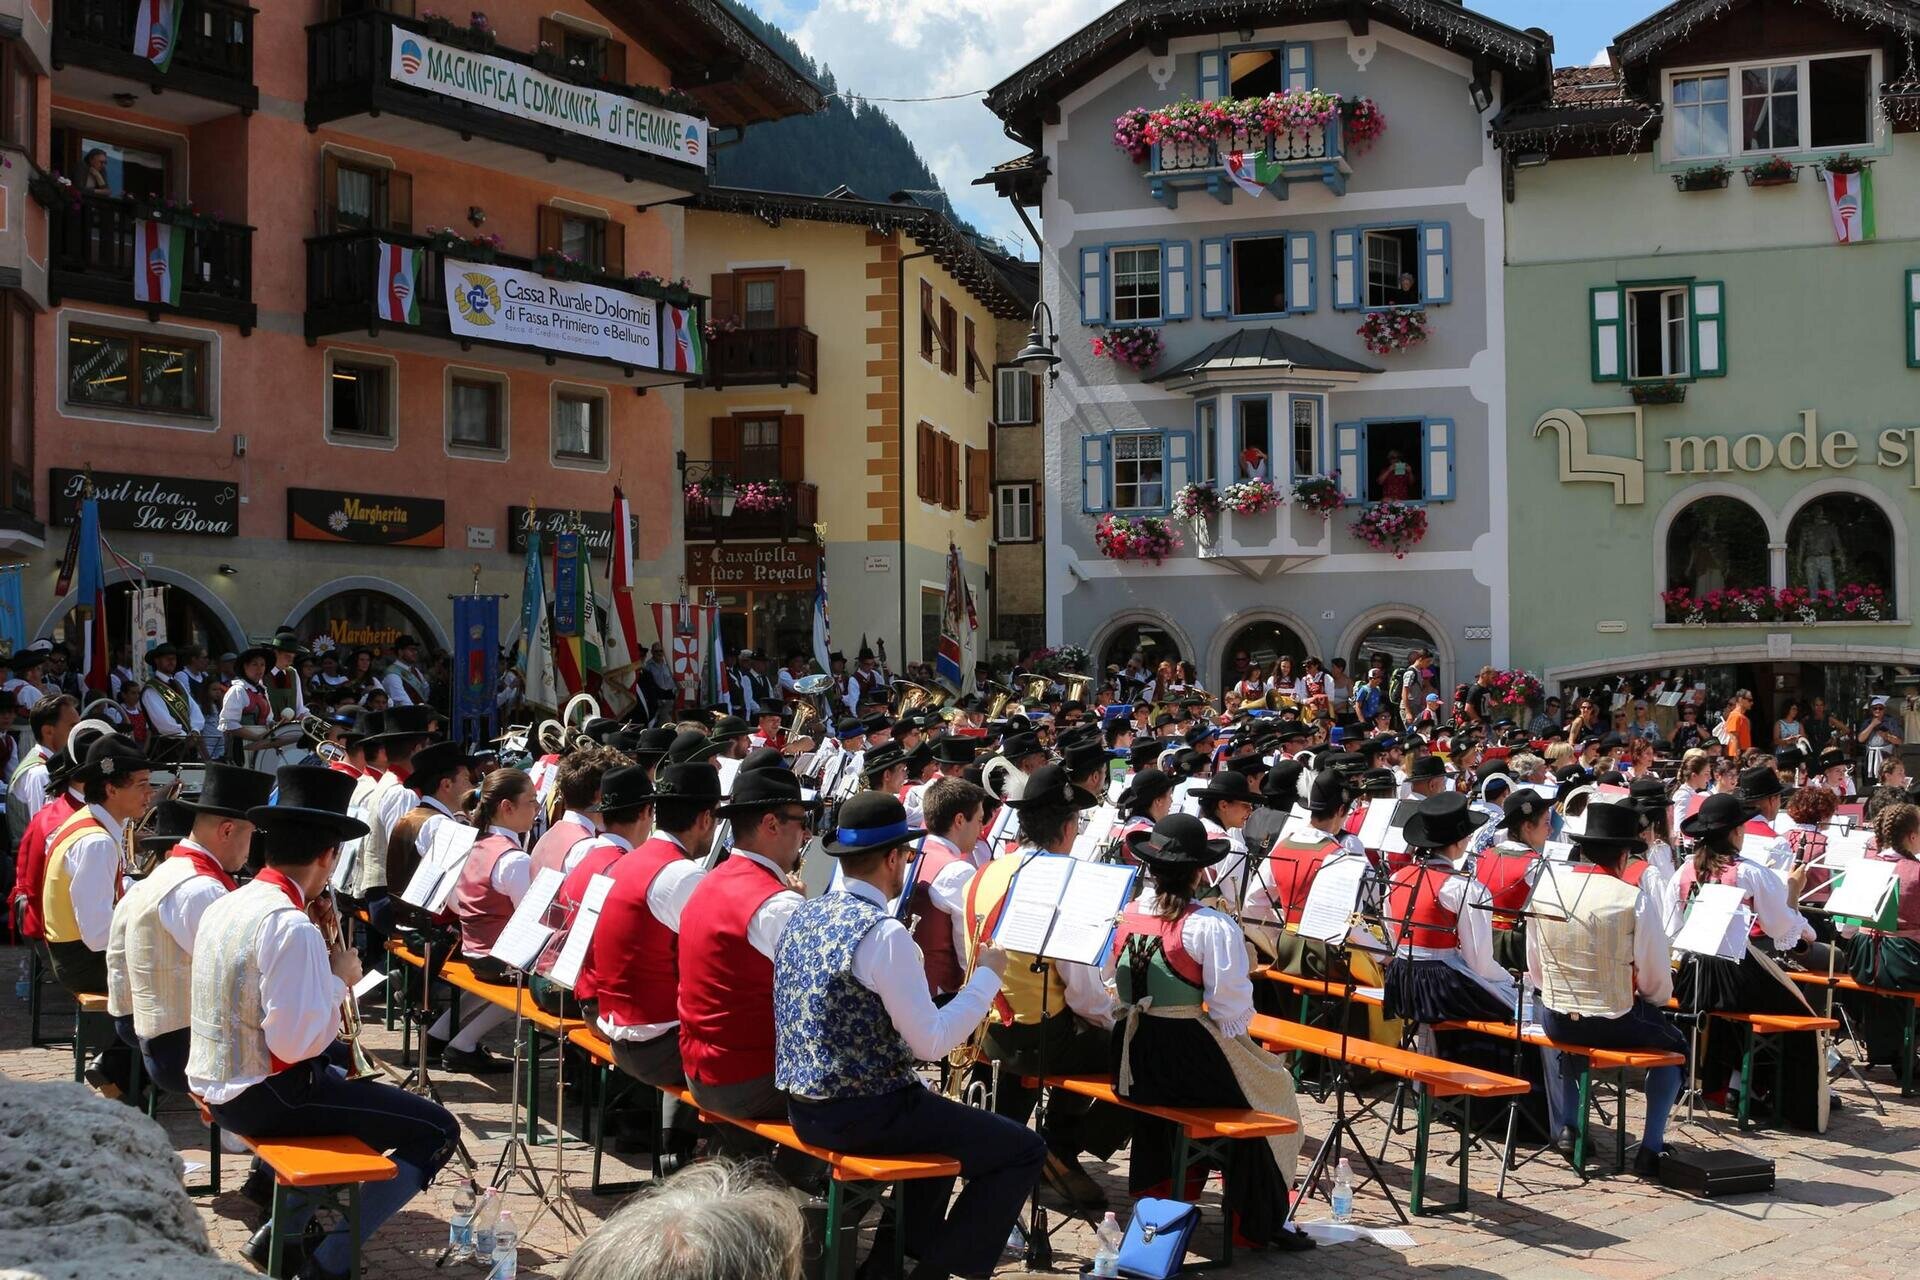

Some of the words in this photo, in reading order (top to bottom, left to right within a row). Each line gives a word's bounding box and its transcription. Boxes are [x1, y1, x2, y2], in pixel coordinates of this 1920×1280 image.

[427, 46, 518, 105] MAGNIFICA
[522, 77, 601, 128] COMUNITÀ
[608, 104, 622, 134] di
[626, 108, 682, 151] FIEMME
[504, 278, 545, 305] Cassa
[549, 286, 592, 313] Rurale
[595, 296, 651, 326] Dolomiti
[505, 306, 515, 321] di
[518, 307, 549, 327] Fassa
[552, 313, 600, 336] Primiero
[1663, 408, 1859, 475] mode
[63, 474, 133, 502] Tssil
[132, 505, 168, 529] La
[171, 507, 233, 534] Bora
[343, 497, 408, 526] Margherita
[752, 564, 813, 584] Regalo
